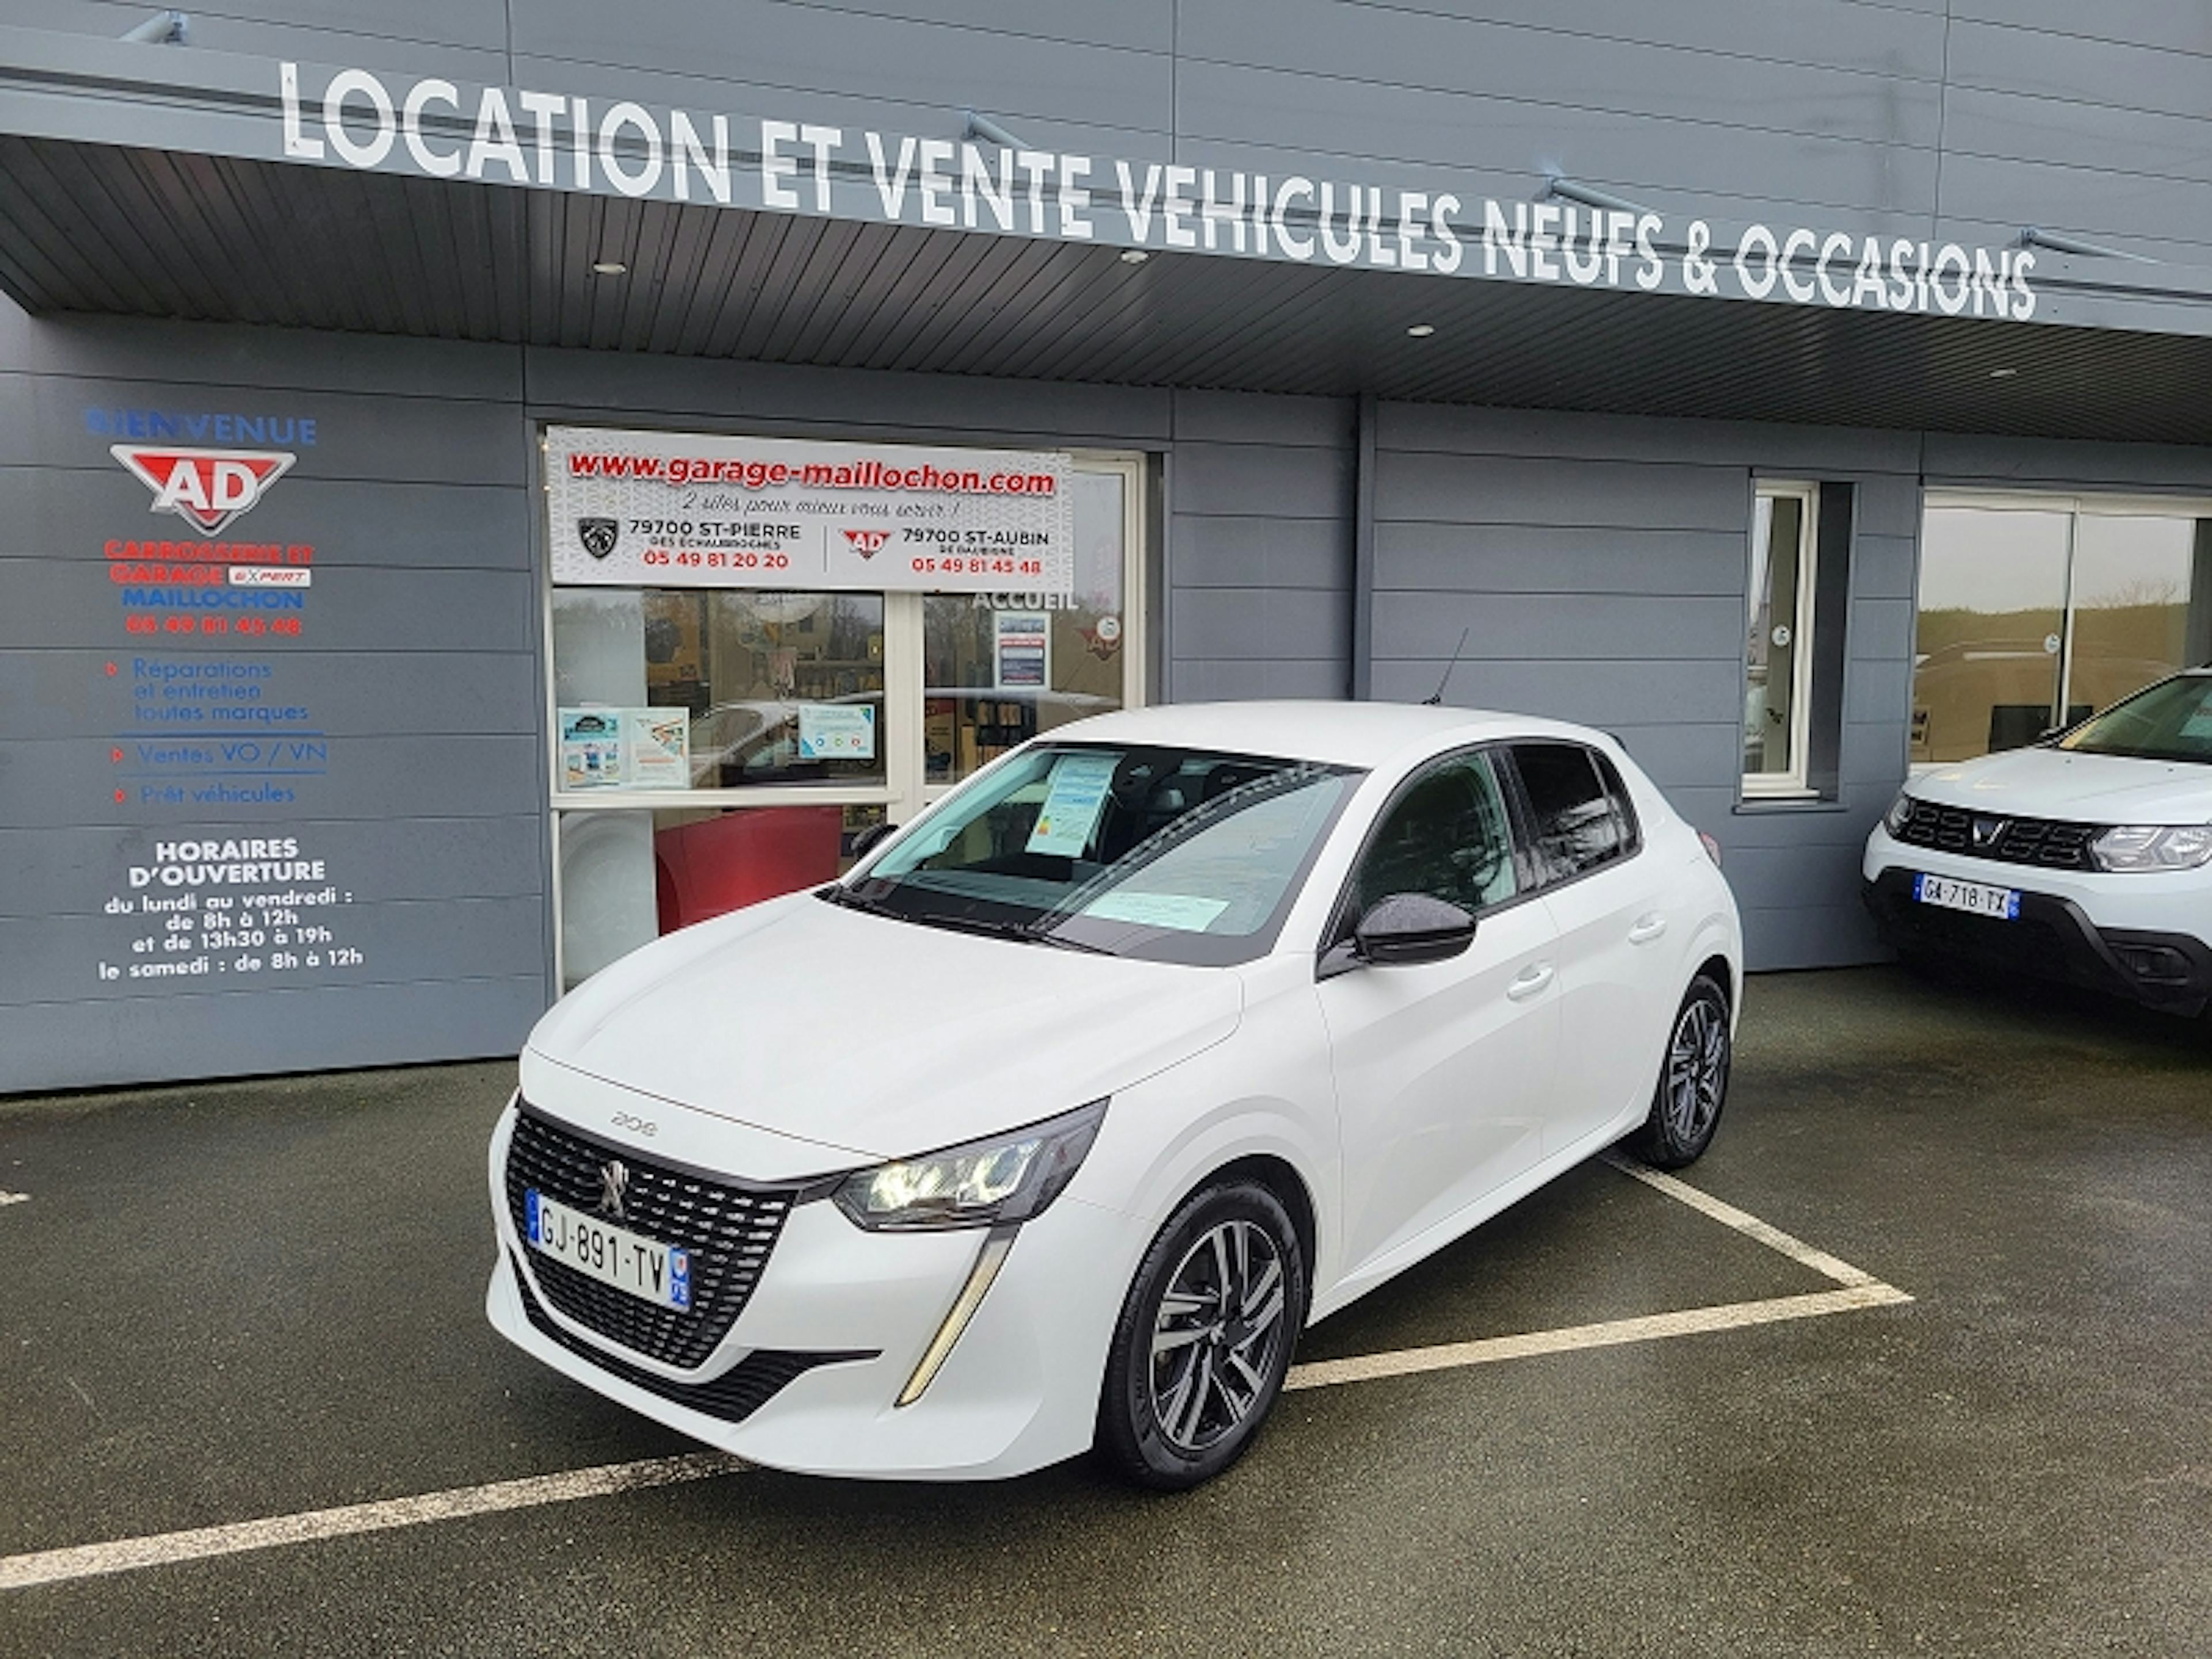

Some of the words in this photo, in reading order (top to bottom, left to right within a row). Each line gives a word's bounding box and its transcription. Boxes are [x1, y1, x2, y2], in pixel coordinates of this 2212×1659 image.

[280, 62, 731, 204] LOCATION
[761, 120, 842, 212] ET
[865, 131, 1093, 238] VENTE
[1115, 160, 1463, 274] VEHICULES
[1483, 199, 1664, 289] NEUFS
[1683, 220, 1718, 294] &
[1733, 224, 2037, 321] OCCASIONS
[87, 408, 317, 445] BIENVENUE
[156, 460, 261, 510] AD
[569, 453, 1055, 495] www.garage-maillochon.com
[683, 491, 698, 510] 2
[629, 520, 693, 535] 79700
[699, 522, 801, 539] ST-PIERRE
[903, 528, 960, 542] 79700
[964, 531, 1048, 545] ST-AUBIN
[104, 539, 282, 564] CARROSSERIE
[287, 544, 314, 564] ET
[850, 532, 884, 551] AD
[644, 550, 669, 565] 05
[677, 552, 701, 566] 49
[707, 552, 726, 567] 81
[733, 553, 757, 568] 20
[763, 554, 789, 569] 20
[912, 558, 934, 571] 05
[941, 558, 963, 572] 49
[969, 559, 987, 572] 81
[109, 563, 224, 586] GARAGE
[122, 588, 304, 609] MAILLOCHON
[972, 592, 1080, 610] ACCUEIL
[132, 657, 272, 681] Réparations
[134, 683, 154, 699] et
[163, 682, 261, 699] entretien
[134, 704, 204, 721] toutes
[211, 706, 309, 724] marques
[138, 744, 213, 763] Ventes
[221, 743, 260, 762] VO
[289, 743, 327, 761] VN
[192, 781, 296, 802] véhicules
[156, 837, 299, 863] HORAIRES
[128, 861, 325, 888] D'OUVERTURE
[104, 896, 134, 914] du
[142, 893, 197, 912] lundi
[205, 897, 234, 910] au
[242, 887, 336, 907] vendredi
[1925, 880, 2005, 912] GA-718-TX
[165, 914, 194, 931] de
[203, 912, 230, 929] 8h
[262, 908, 299, 926] 12h
[132, 936, 154, 952] et
[164, 934, 192, 952] de
[200, 930, 265, 949] 13h30
[274, 929, 288, 945] à
[295, 926, 333, 944] 19h
[98, 961, 120, 980] le
[128, 956, 210, 978] samedi
[234, 953, 262, 972] de
[270, 952, 298, 969] 8h
[305, 950, 320, 967] à
[327, 948, 363, 966] 12h
[543, 1208, 664, 1293] GJ-891-TV
